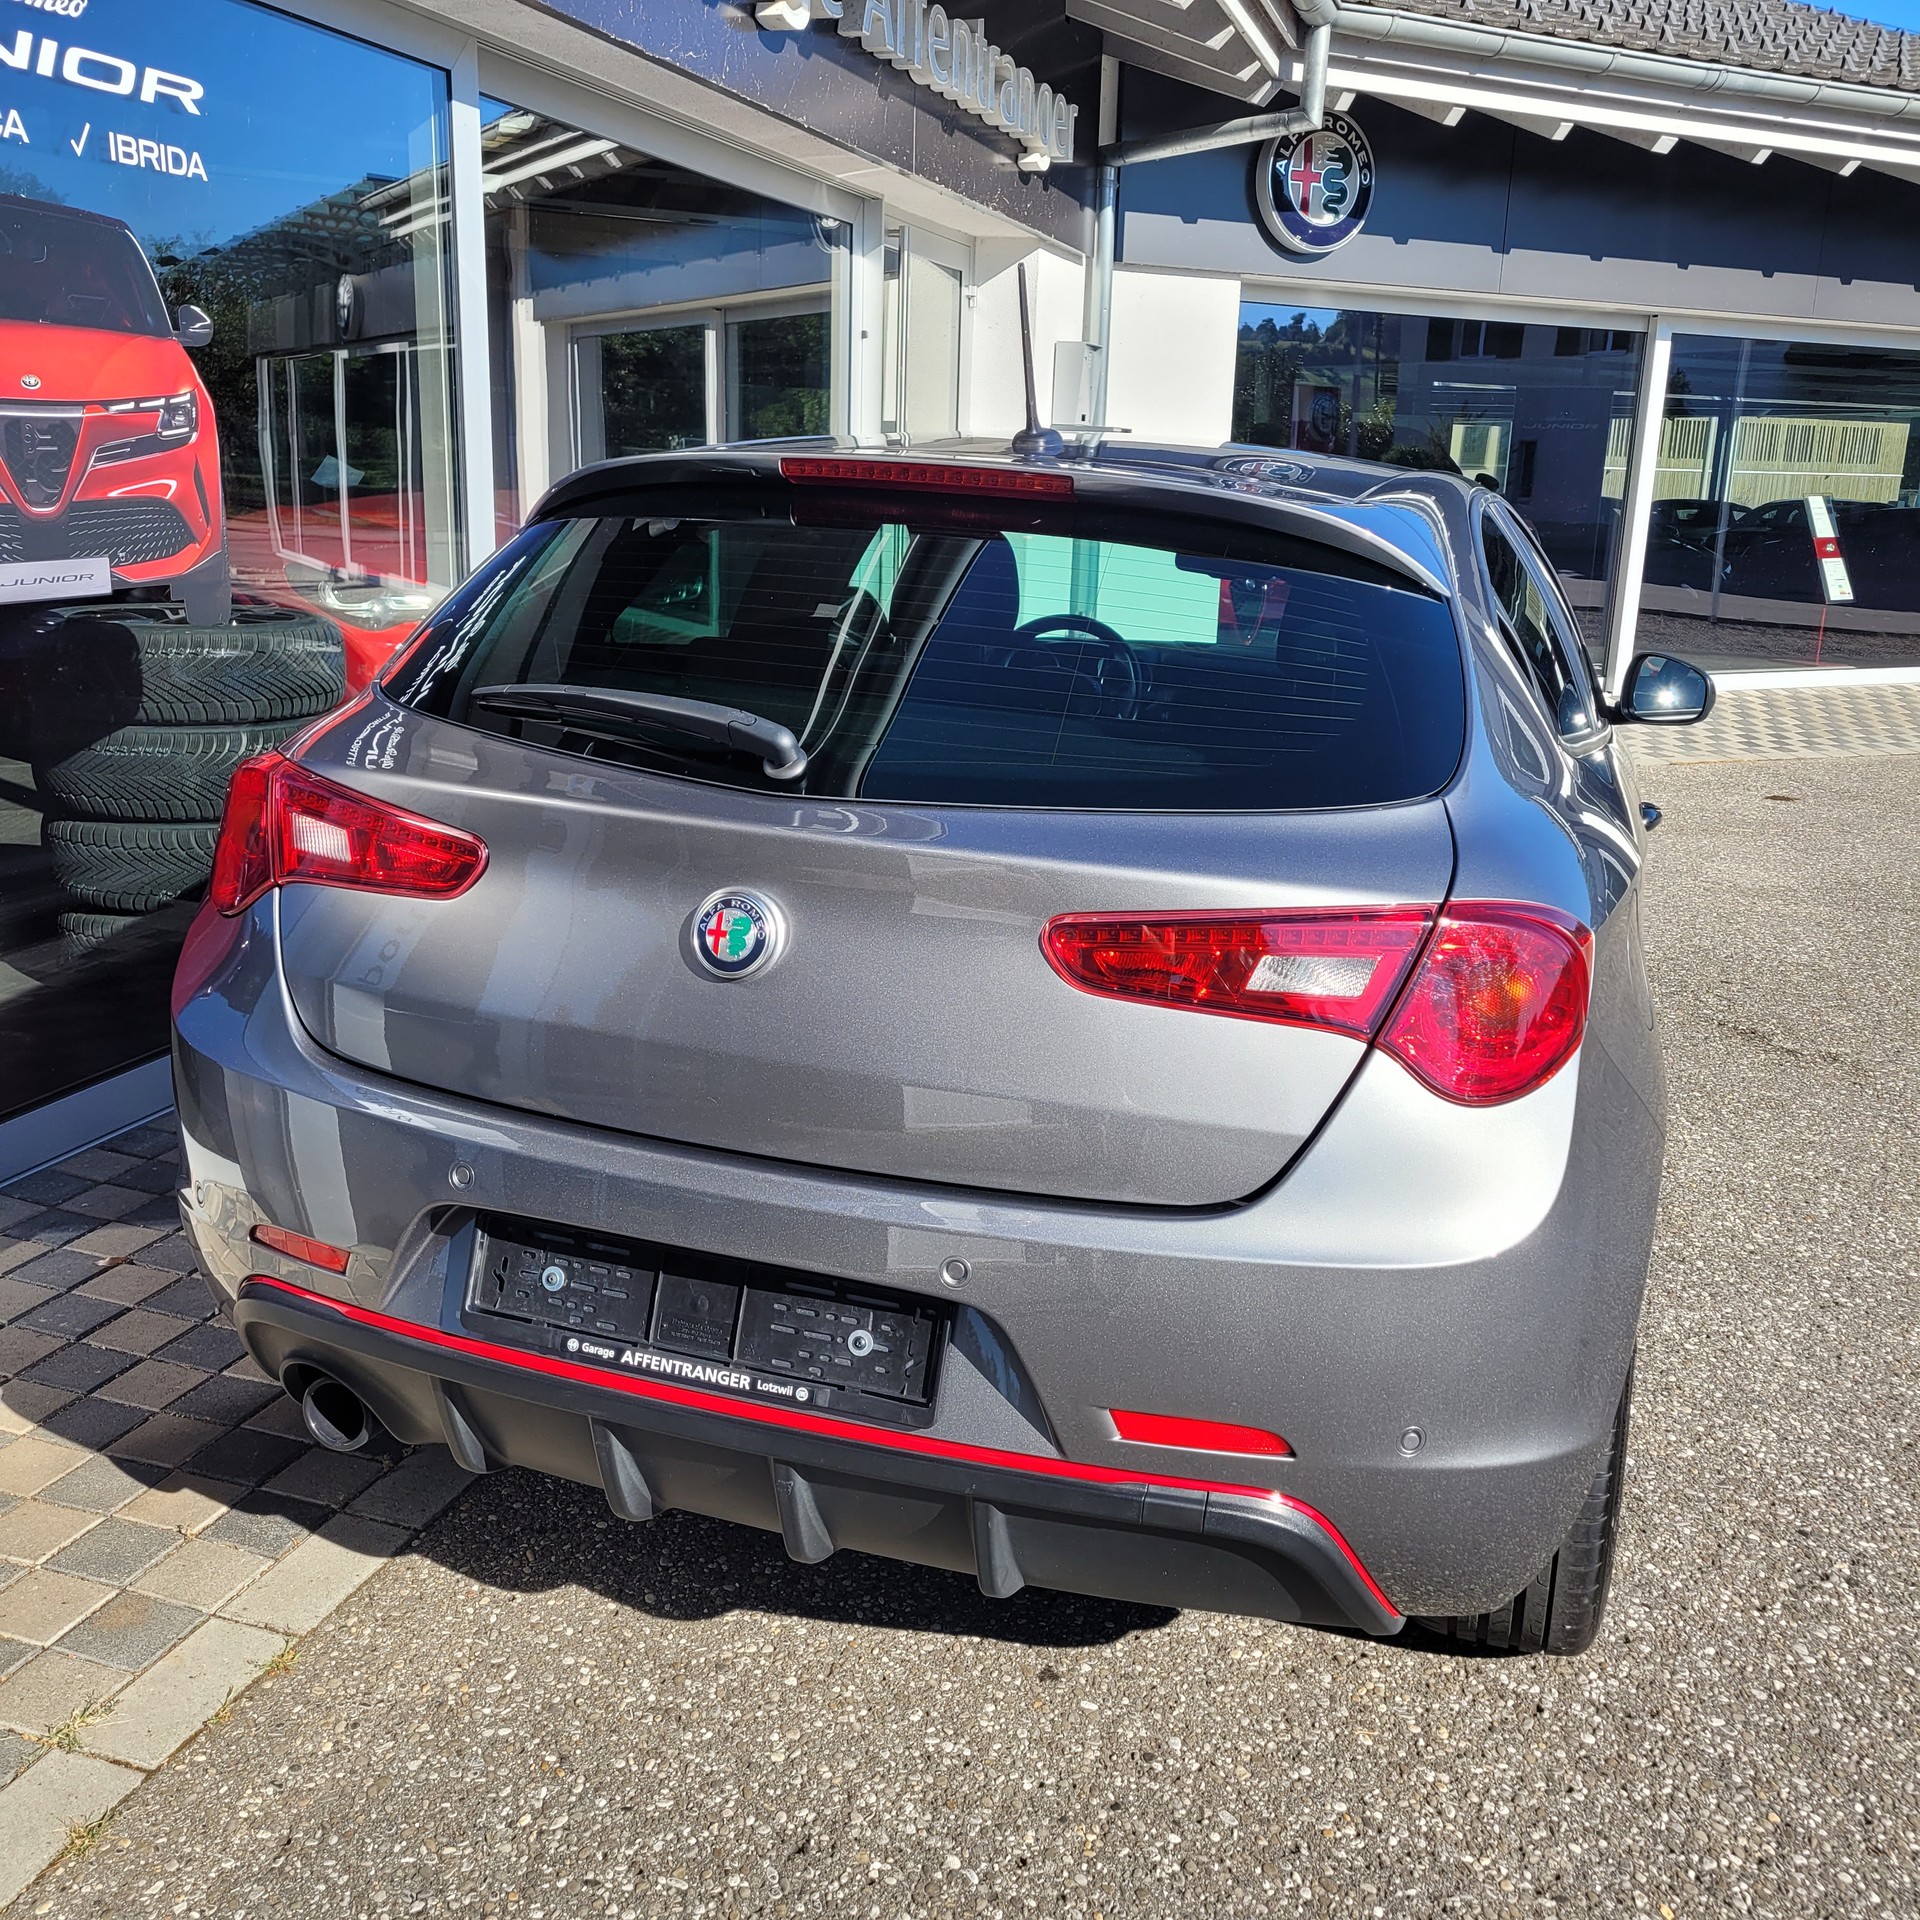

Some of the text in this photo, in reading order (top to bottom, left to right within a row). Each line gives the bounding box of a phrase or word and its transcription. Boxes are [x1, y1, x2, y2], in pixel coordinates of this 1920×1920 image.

[0, 108, 208, 182] A IBRIDA
[1275, 115, 1371, 186] ALF ROMEO
[0, 573, 95, 587] JUNIOR
[699, 899, 766, 941] ALFA ROMEO
[581, 1342, 793, 1397] Garage AFFENTRANGER Lotzwil
